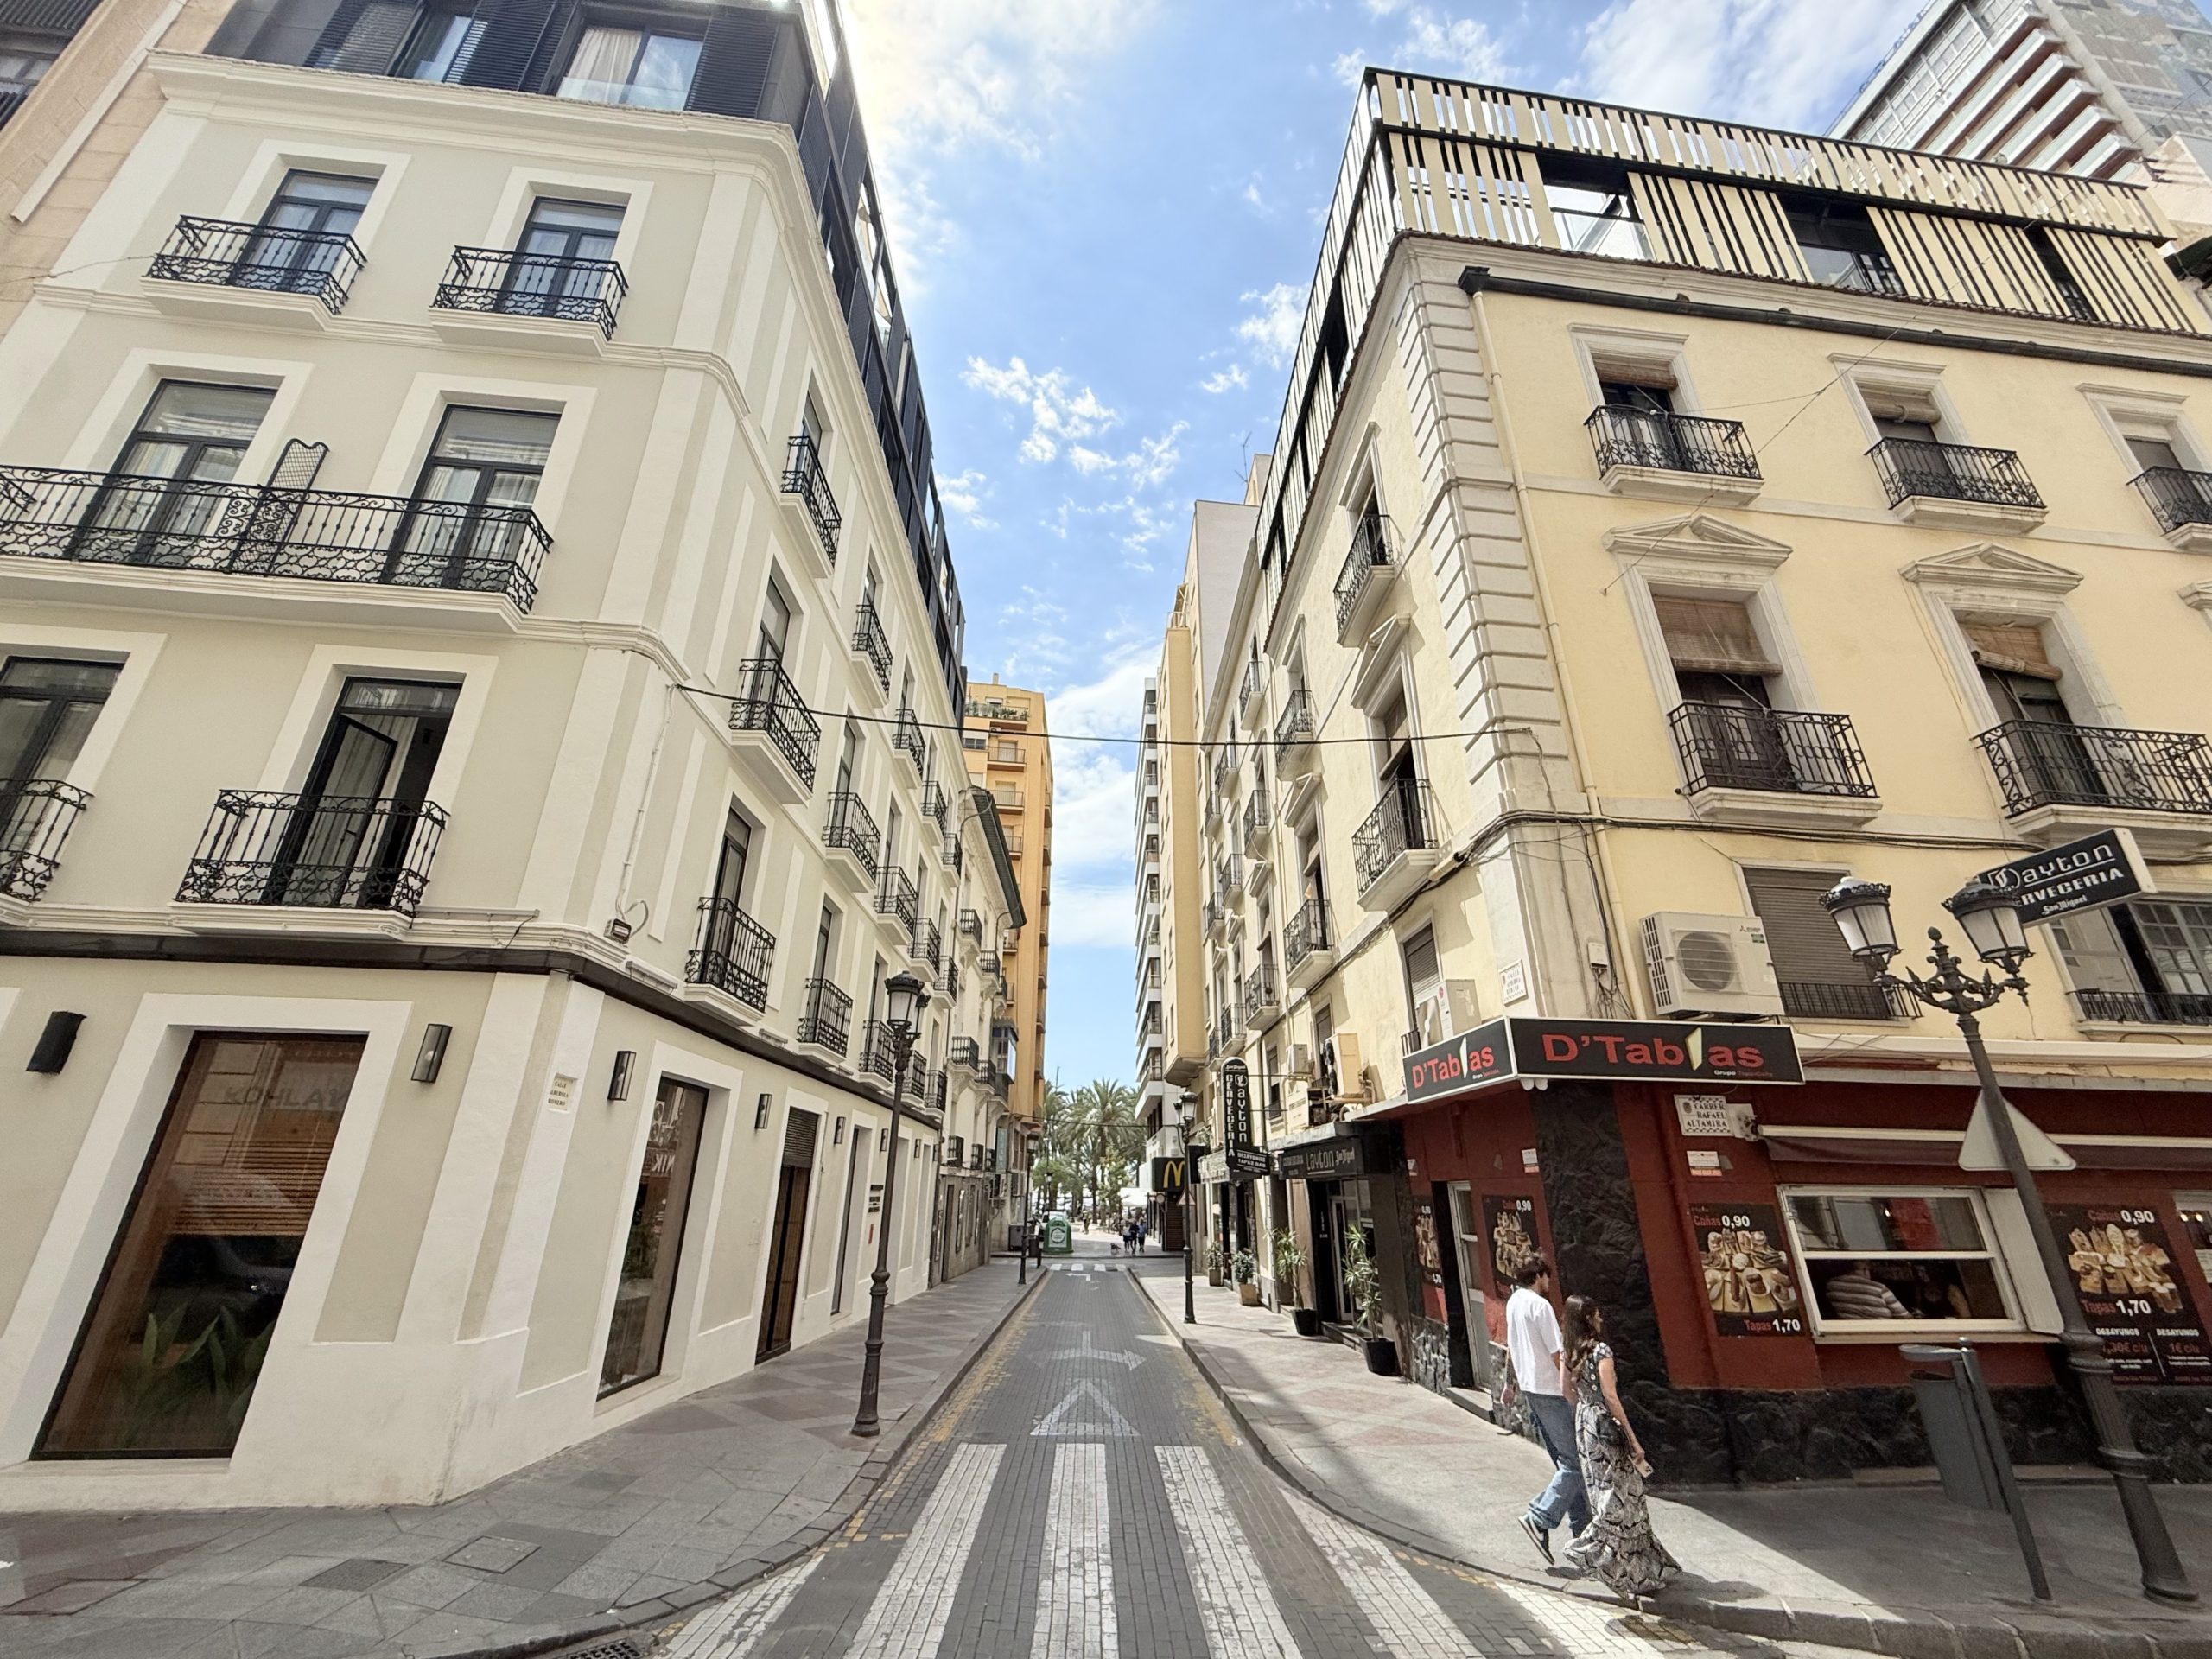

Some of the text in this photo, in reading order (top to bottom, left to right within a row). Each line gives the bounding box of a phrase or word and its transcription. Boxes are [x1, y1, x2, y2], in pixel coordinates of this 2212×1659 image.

[2017, 868, 2124, 907] RVECERIA
[2056, 894, 2088, 911] Miguel
[1687, 1119, 1728, 1128] ALTAMIRA
[1516, 1199, 1532, 1212] 0,90
[1693, 1215, 1751, 1229] Cañas 0,90
[2120, 1210, 2155, 1225] 0,90
[2082, 1300, 2152, 1317] Tapas 1,70
[1744, 1319, 1801, 1333] Tapas 1,70
[2095, 1327, 2140, 1337] DESAYUNOS
[2156, 1328, 2200, 1337] DESAYUNOS
